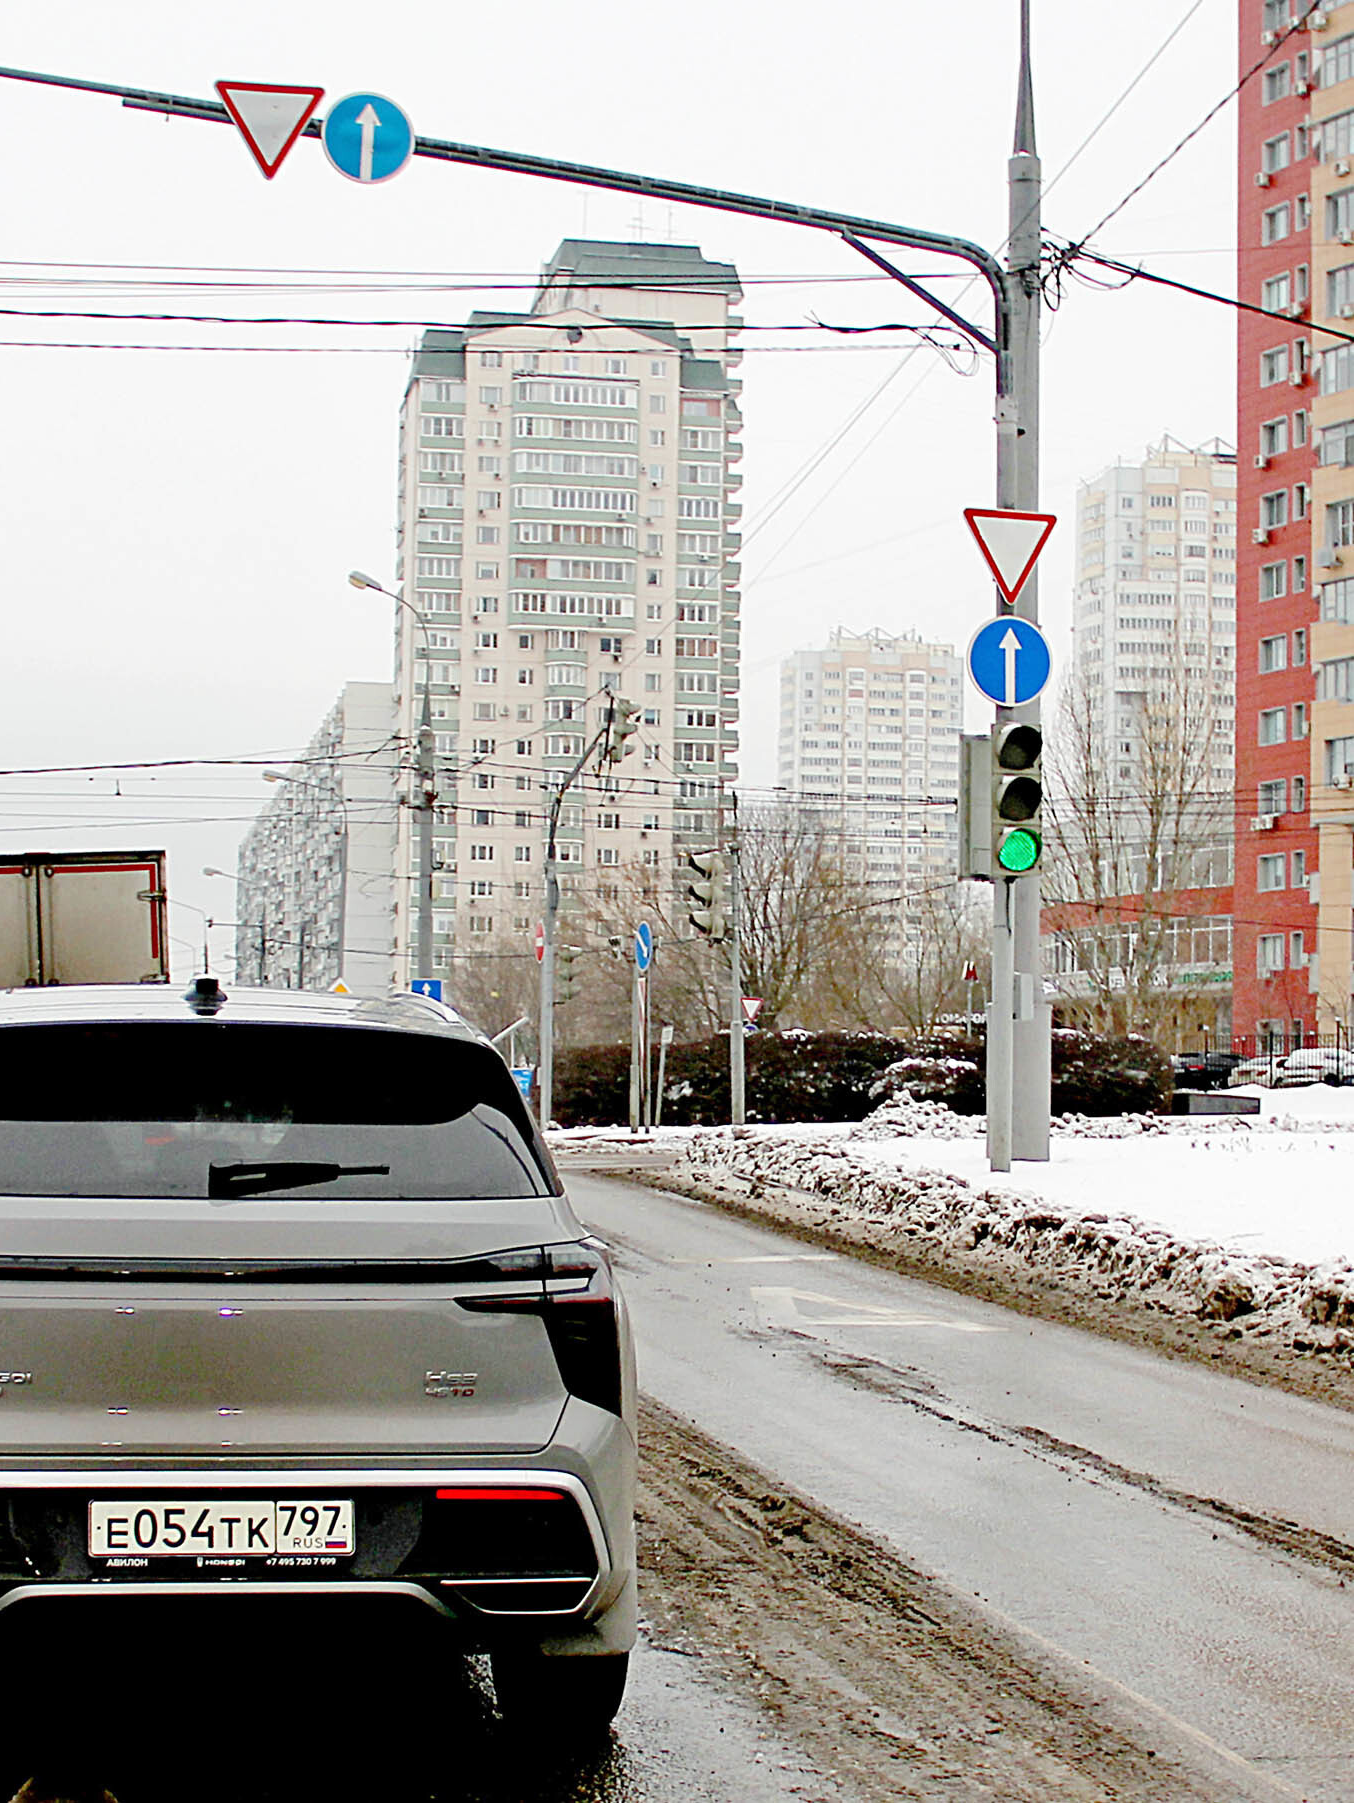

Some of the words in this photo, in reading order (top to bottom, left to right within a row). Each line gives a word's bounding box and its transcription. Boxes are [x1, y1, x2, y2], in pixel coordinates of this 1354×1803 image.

[107, 1508, 269, 1548] Е054ТК
[278, 1506, 341, 1537] 797
[292, 1537, 324, 1549] RUS
[106, 1558, 149, 1567] АВИЛОН
[278, 1558, 295, 1566] 495
[313, 1558, 320, 1566] 7
